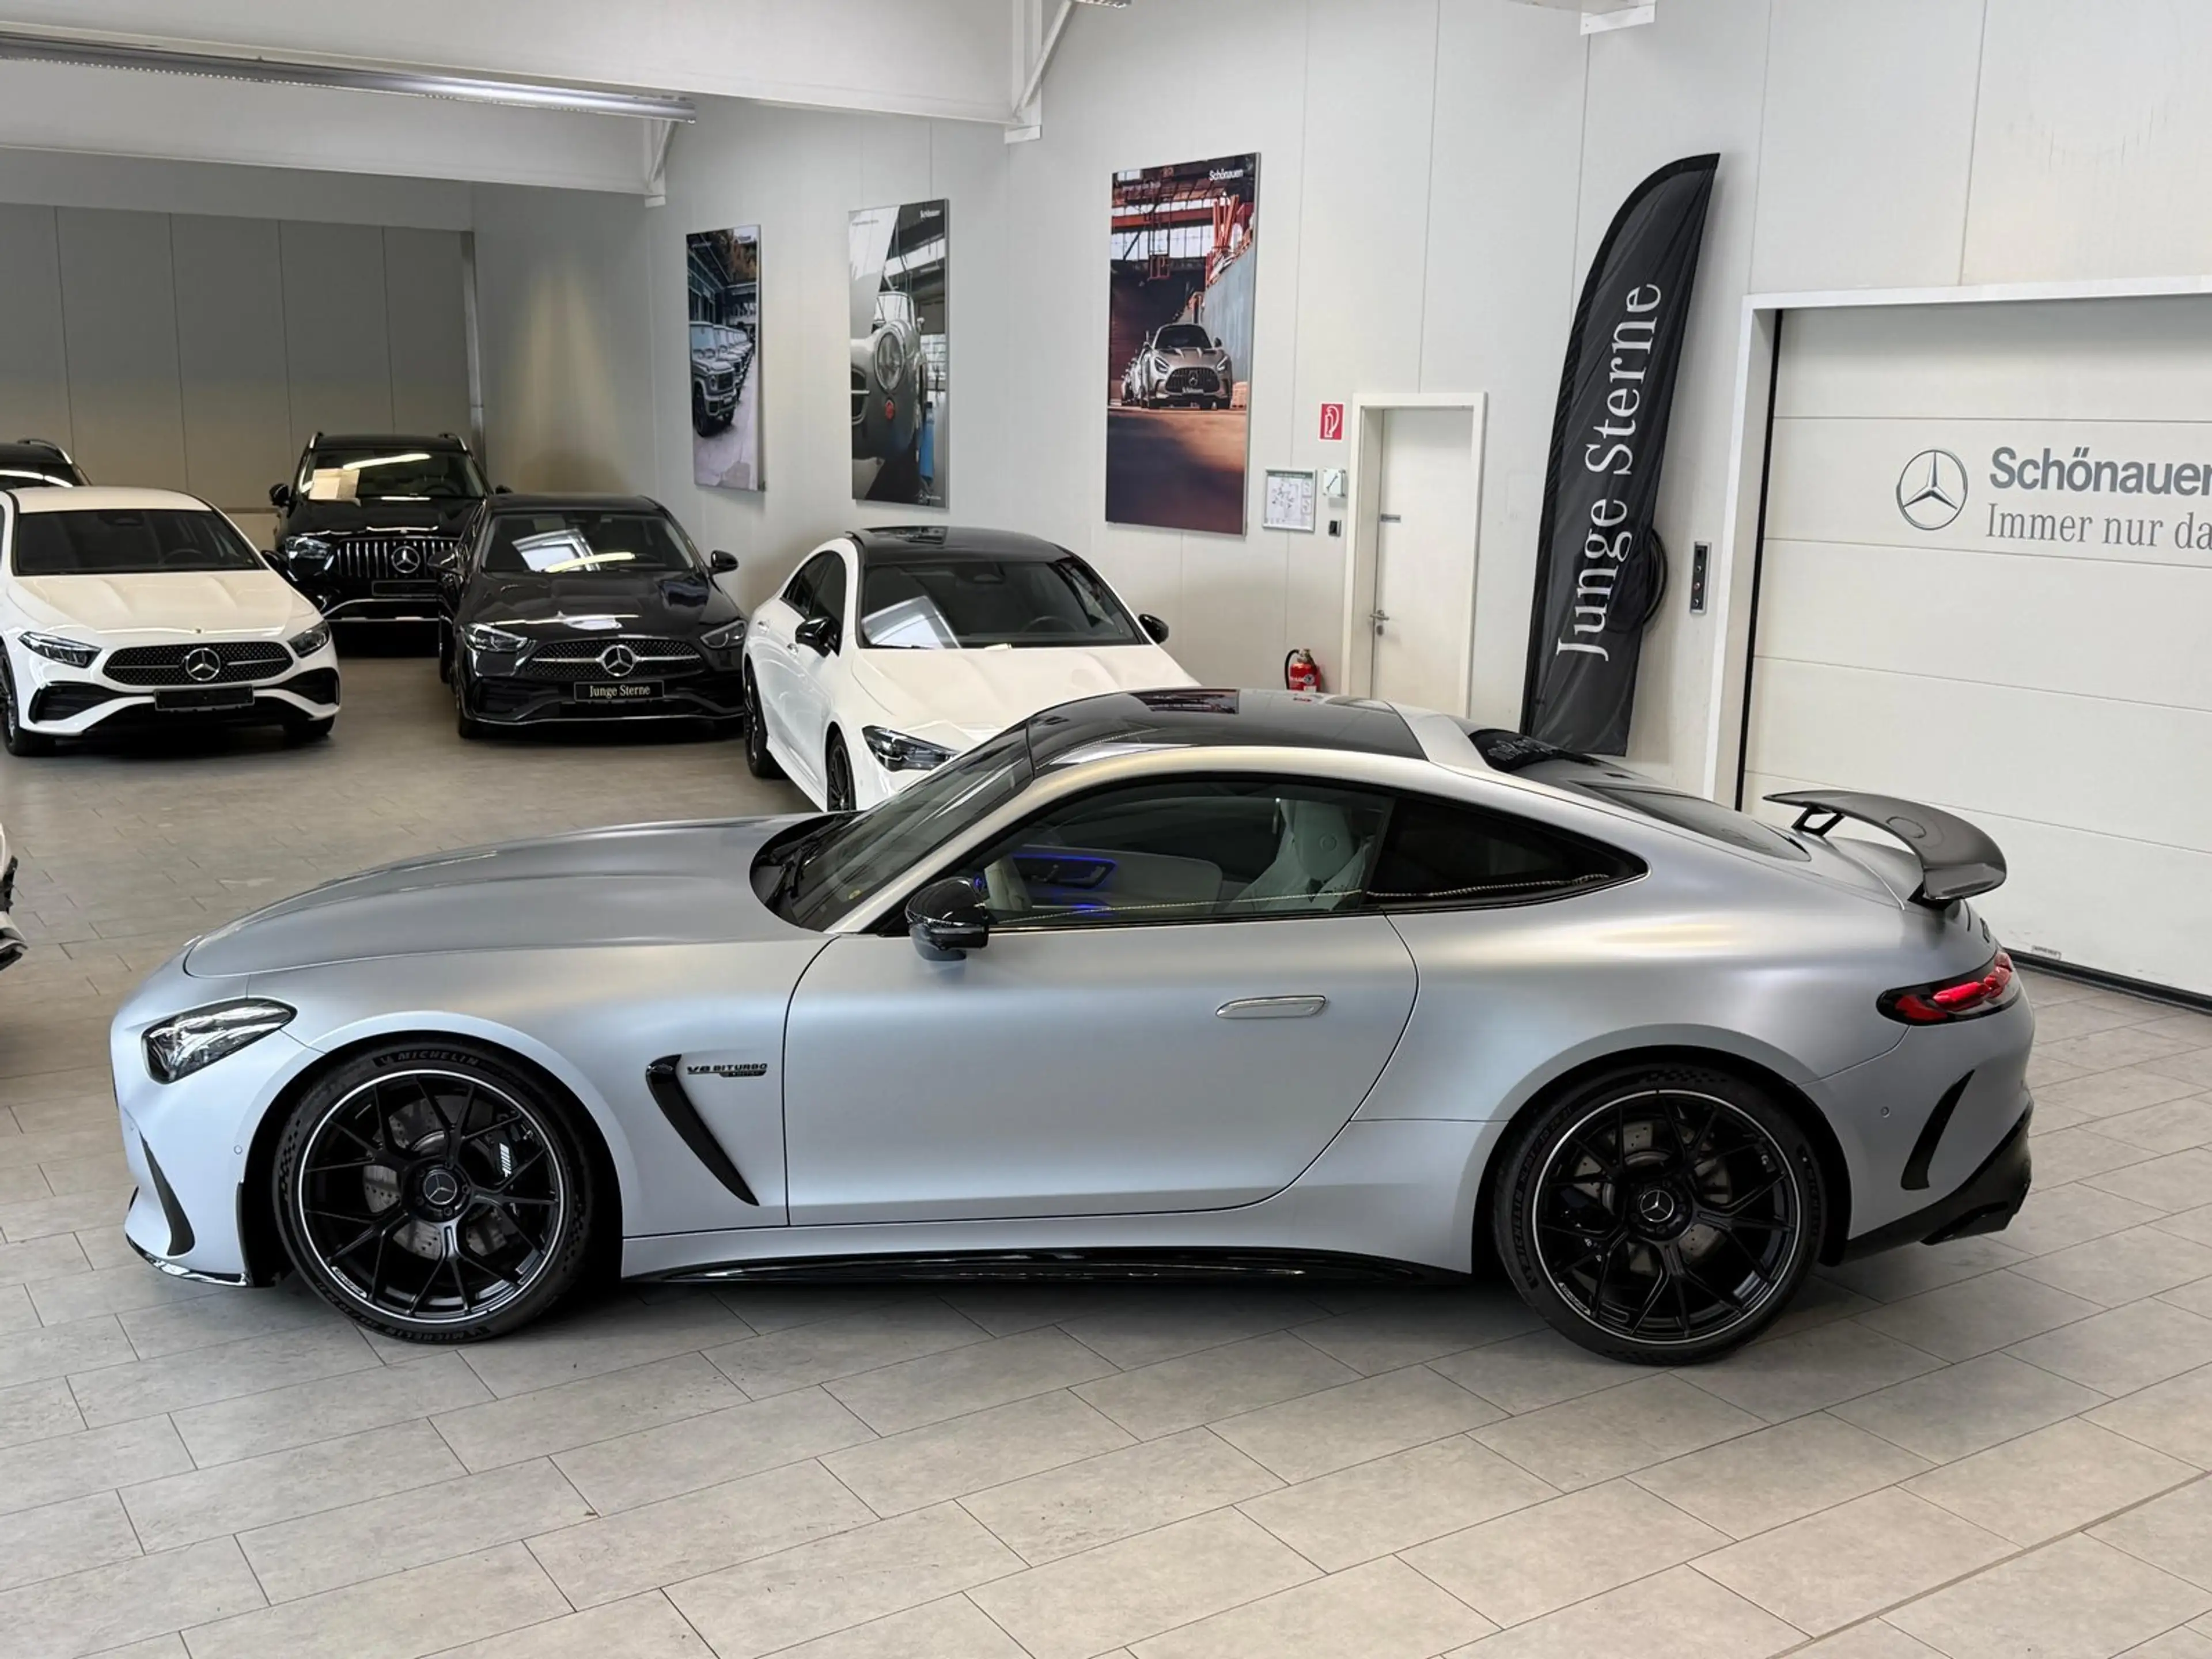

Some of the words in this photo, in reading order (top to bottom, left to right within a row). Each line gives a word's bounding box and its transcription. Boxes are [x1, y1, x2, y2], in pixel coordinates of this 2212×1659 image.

[1586, 283, 1661, 475] Sterne
[1986, 503, 2092, 542] Immer
[2103, 516, 2163, 547] nur
[1556, 499, 1632, 661] Junge
[590, 685, 618, 699] Junge
[620, 684, 650, 696] Sterne
[397, 1050, 479, 1067] MICHELIN
